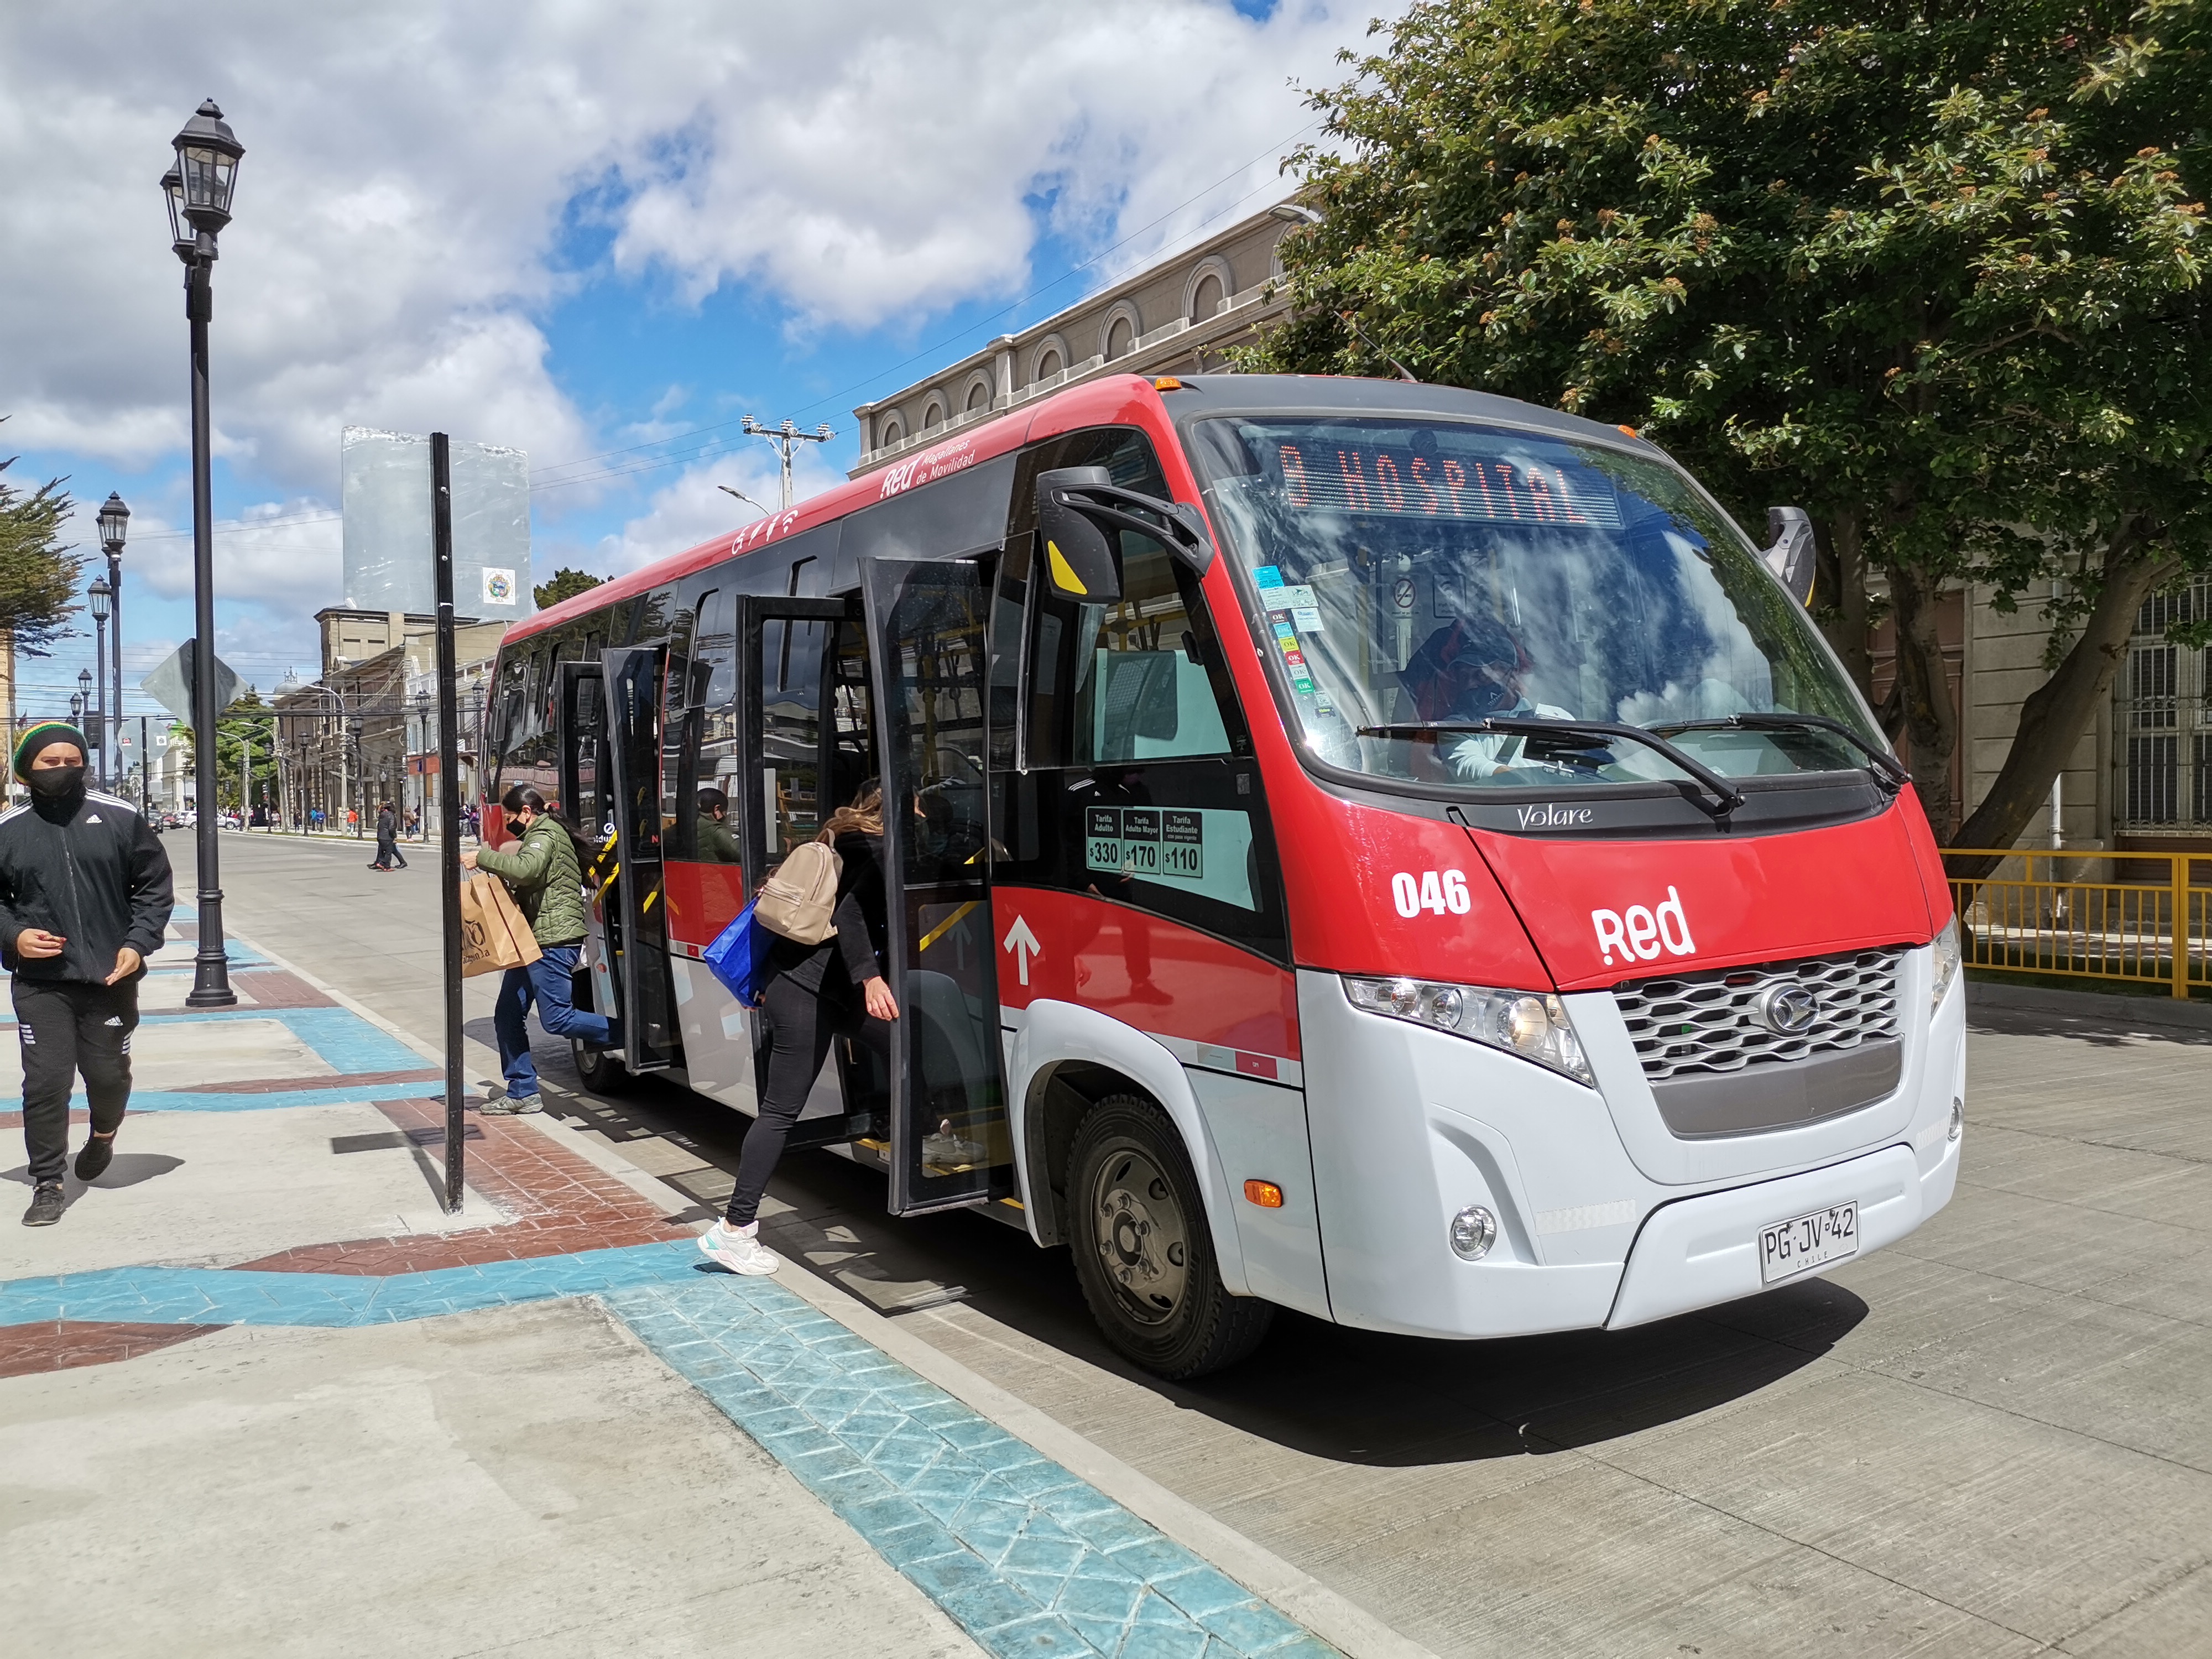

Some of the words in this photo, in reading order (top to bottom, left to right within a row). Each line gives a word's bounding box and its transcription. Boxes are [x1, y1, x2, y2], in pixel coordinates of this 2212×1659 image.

[921, 440, 971, 467] Magallanes
[880, 453, 925, 499] Red
[916, 471, 926, 485] de
[930, 449, 975, 479] Movilidad
[1337, 450, 1587, 523] HOSPITAL
[1094, 823, 1113, 832] Adulto
[1095, 814, 1113, 823] Tarifa
[1134, 816, 1149, 825] Tarifa
[1172, 815, 1191, 825] Tarifa
[1517, 803, 1593, 830] Volare
[1125, 825, 1142, 833] Adulto
[1142, 826, 1159, 836] Mayor
[1166, 824, 1198, 834] Estudiante
[1089, 842, 1118, 864] $330
[1125, 844, 1156, 868] $170
[1165, 847, 1198, 870] $110
[1391, 869, 1471, 919] 046
[1591, 885, 1697, 966] Red
[1797, 1250, 1828, 1268] CHILE
